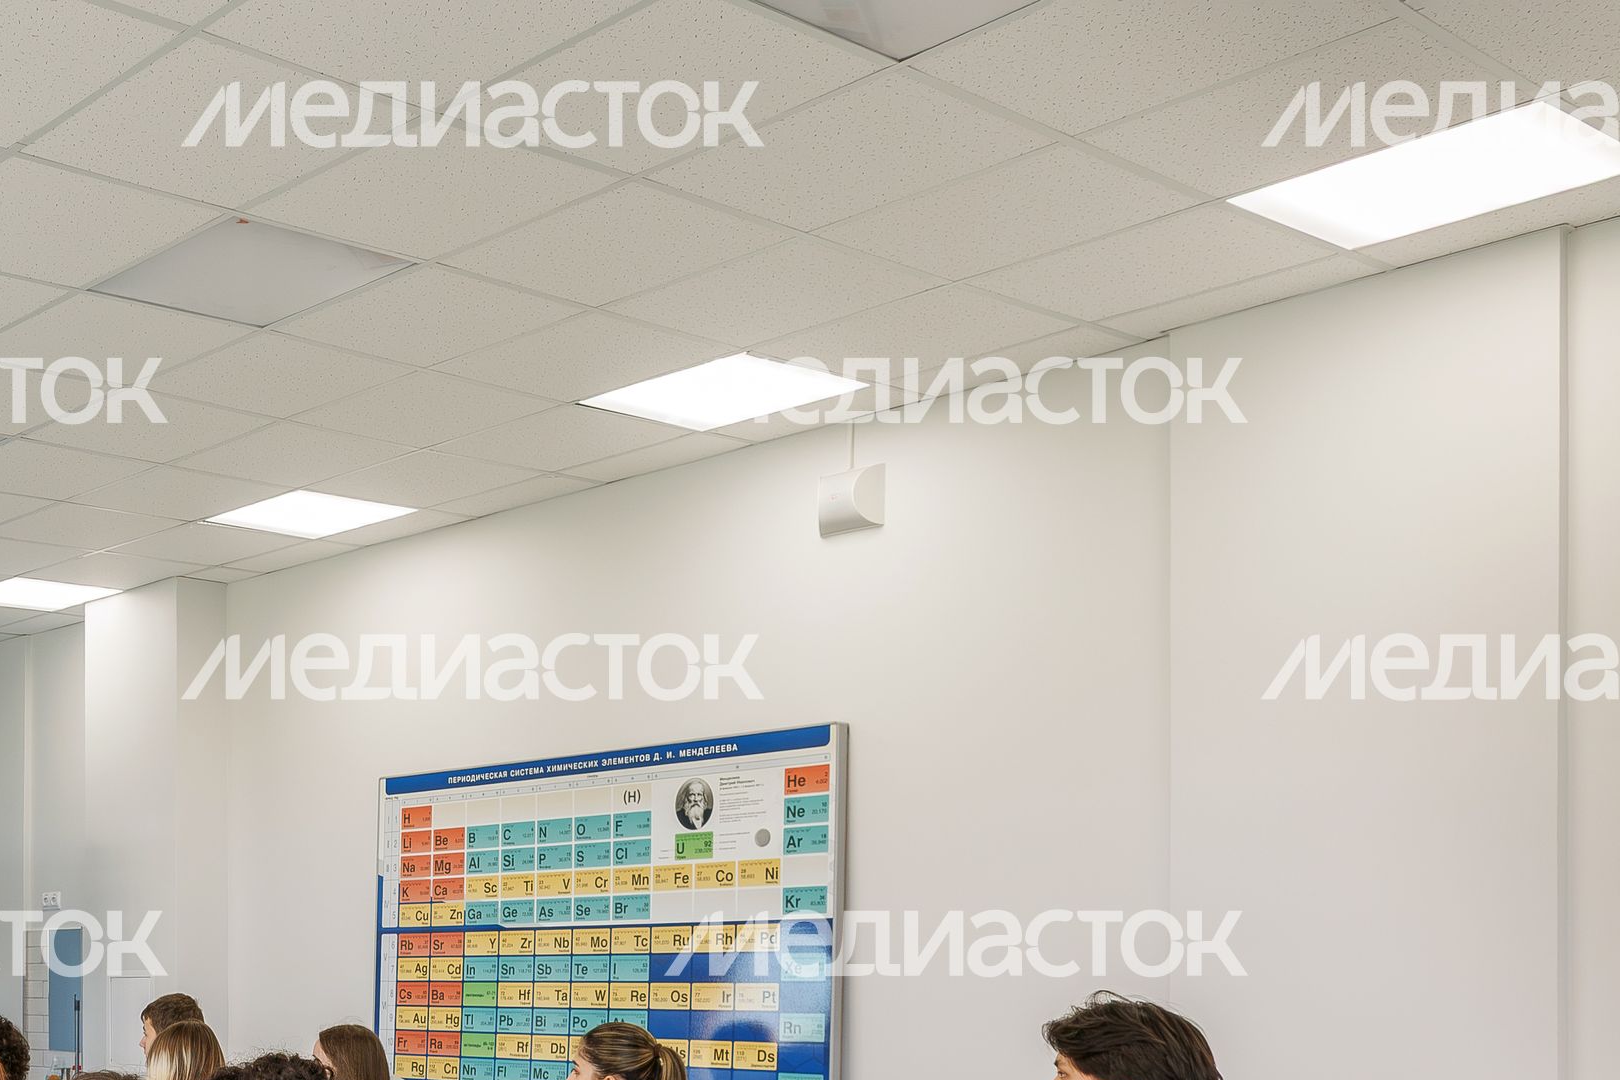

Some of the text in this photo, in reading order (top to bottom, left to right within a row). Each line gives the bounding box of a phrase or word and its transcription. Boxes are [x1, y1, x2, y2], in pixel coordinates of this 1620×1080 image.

[448, 744, 738, 785] ПЕРИОДИЧЕСКАЯ СИСТЕМА ХИМИЧЕСКИХ ЭЛЕМЕНТОВ Д. И. МЕНДЕЛЕЕВА
[787, 776, 806, 788] He
[623, 789, 641, 805] (H)
[787, 806, 805, 818] Ne
[403, 813, 410, 824] H
[577, 824, 586, 836] O
[615, 821, 623, 832] F
[468, 833, 476, 843] B
[503, 829, 511, 840] C
[540, 827, 547, 838] N
[403, 838, 412, 849] Li
[435, 835, 448, 846] Be
[786, 836, 803, 848] Ar
[615, 848, 628, 860] Cl
[677, 843, 684, 854] U
[503, 855, 514, 867] Si
[539, 854, 546, 864] P
[577, 850, 584, 862] S
[403, 862, 415, 873] Na
[435, 860, 451, 874] Mg
[469, 857, 480, 868] Al
[674, 873, 689, 884] Fe
[716, 870, 733, 882] Co
[765, 867, 778, 880] Ni
[524, 880, 533, 891] Ti
[563, 879, 570, 889] V
[595, 877, 608, 888] Cr
[632, 874, 649, 886] Mn
[402, 887, 409, 897] K
[434, 885, 447, 896] Ca
[484, 882, 497, 893] Sc
[785, 896, 801, 908] Kr
[503, 906, 518, 917] Ge
[539, 906, 554, 917] As
[576, 904, 590, 916] Se
[615, 902, 628, 914] Br
[415, 911, 429, 921] Cu
[450, 909, 462, 920] Zn
[468, 909, 482, 920] Ga
[489, 938, 496, 949] Y
[520, 938, 532, 949] Zr
[554, 937, 570, 948] Nb
[590, 937, 608, 948] Mo
[634, 935, 648, 947] Tc
[673, 935, 689, 946] Ru
[716, 933, 732, 945] Rh
[400, 940, 413, 950] Rb
[433, 940, 444, 950] Sr
[415, 963, 428, 976] Ag
[447, 963, 461, 975] Cd
[466, 965, 475, 975] In
[501, 964, 515, 975] Sn
[537, 964, 552, 975] Sb
[574, 963, 588, 974] Te
[399, 989, 412, 1000] Cs
[432, 990, 444, 1000] Ba
[519, 990, 530, 1000] Hf
[555, 990, 568, 1001] Ta
[595, 990, 606, 1001] W
[631, 990, 646, 1001] Re
[671, 990, 688, 1002] Os
[762, 991, 776, 1004] Pt
[413, 1013, 426, 1024] Au
[446, 1014, 459, 1026] Hg
[464, 1014, 474, 1025] Tl
[500, 1015, 513, 1026] Pb
[535, 1016, 546, 1027] Bi
[572, 1016, 588, 1028] Po
[783, 1021, 802, 1034] Rn
[397, 1037, 407, 1048] Fr
[430, 1038, 442, 1049] Ra
[517, 1042, 528, 1053] Rf
[550, 1043, 566, 1055] Db
[713, 1049, 729, 1061] Mt
[758, 1050, 775, 1062] Ds
[411, 1062, 424, 1075] Rg
[444, 1064, 458, 1075] Cn
[533, 1068, 549, 1080] Mc
